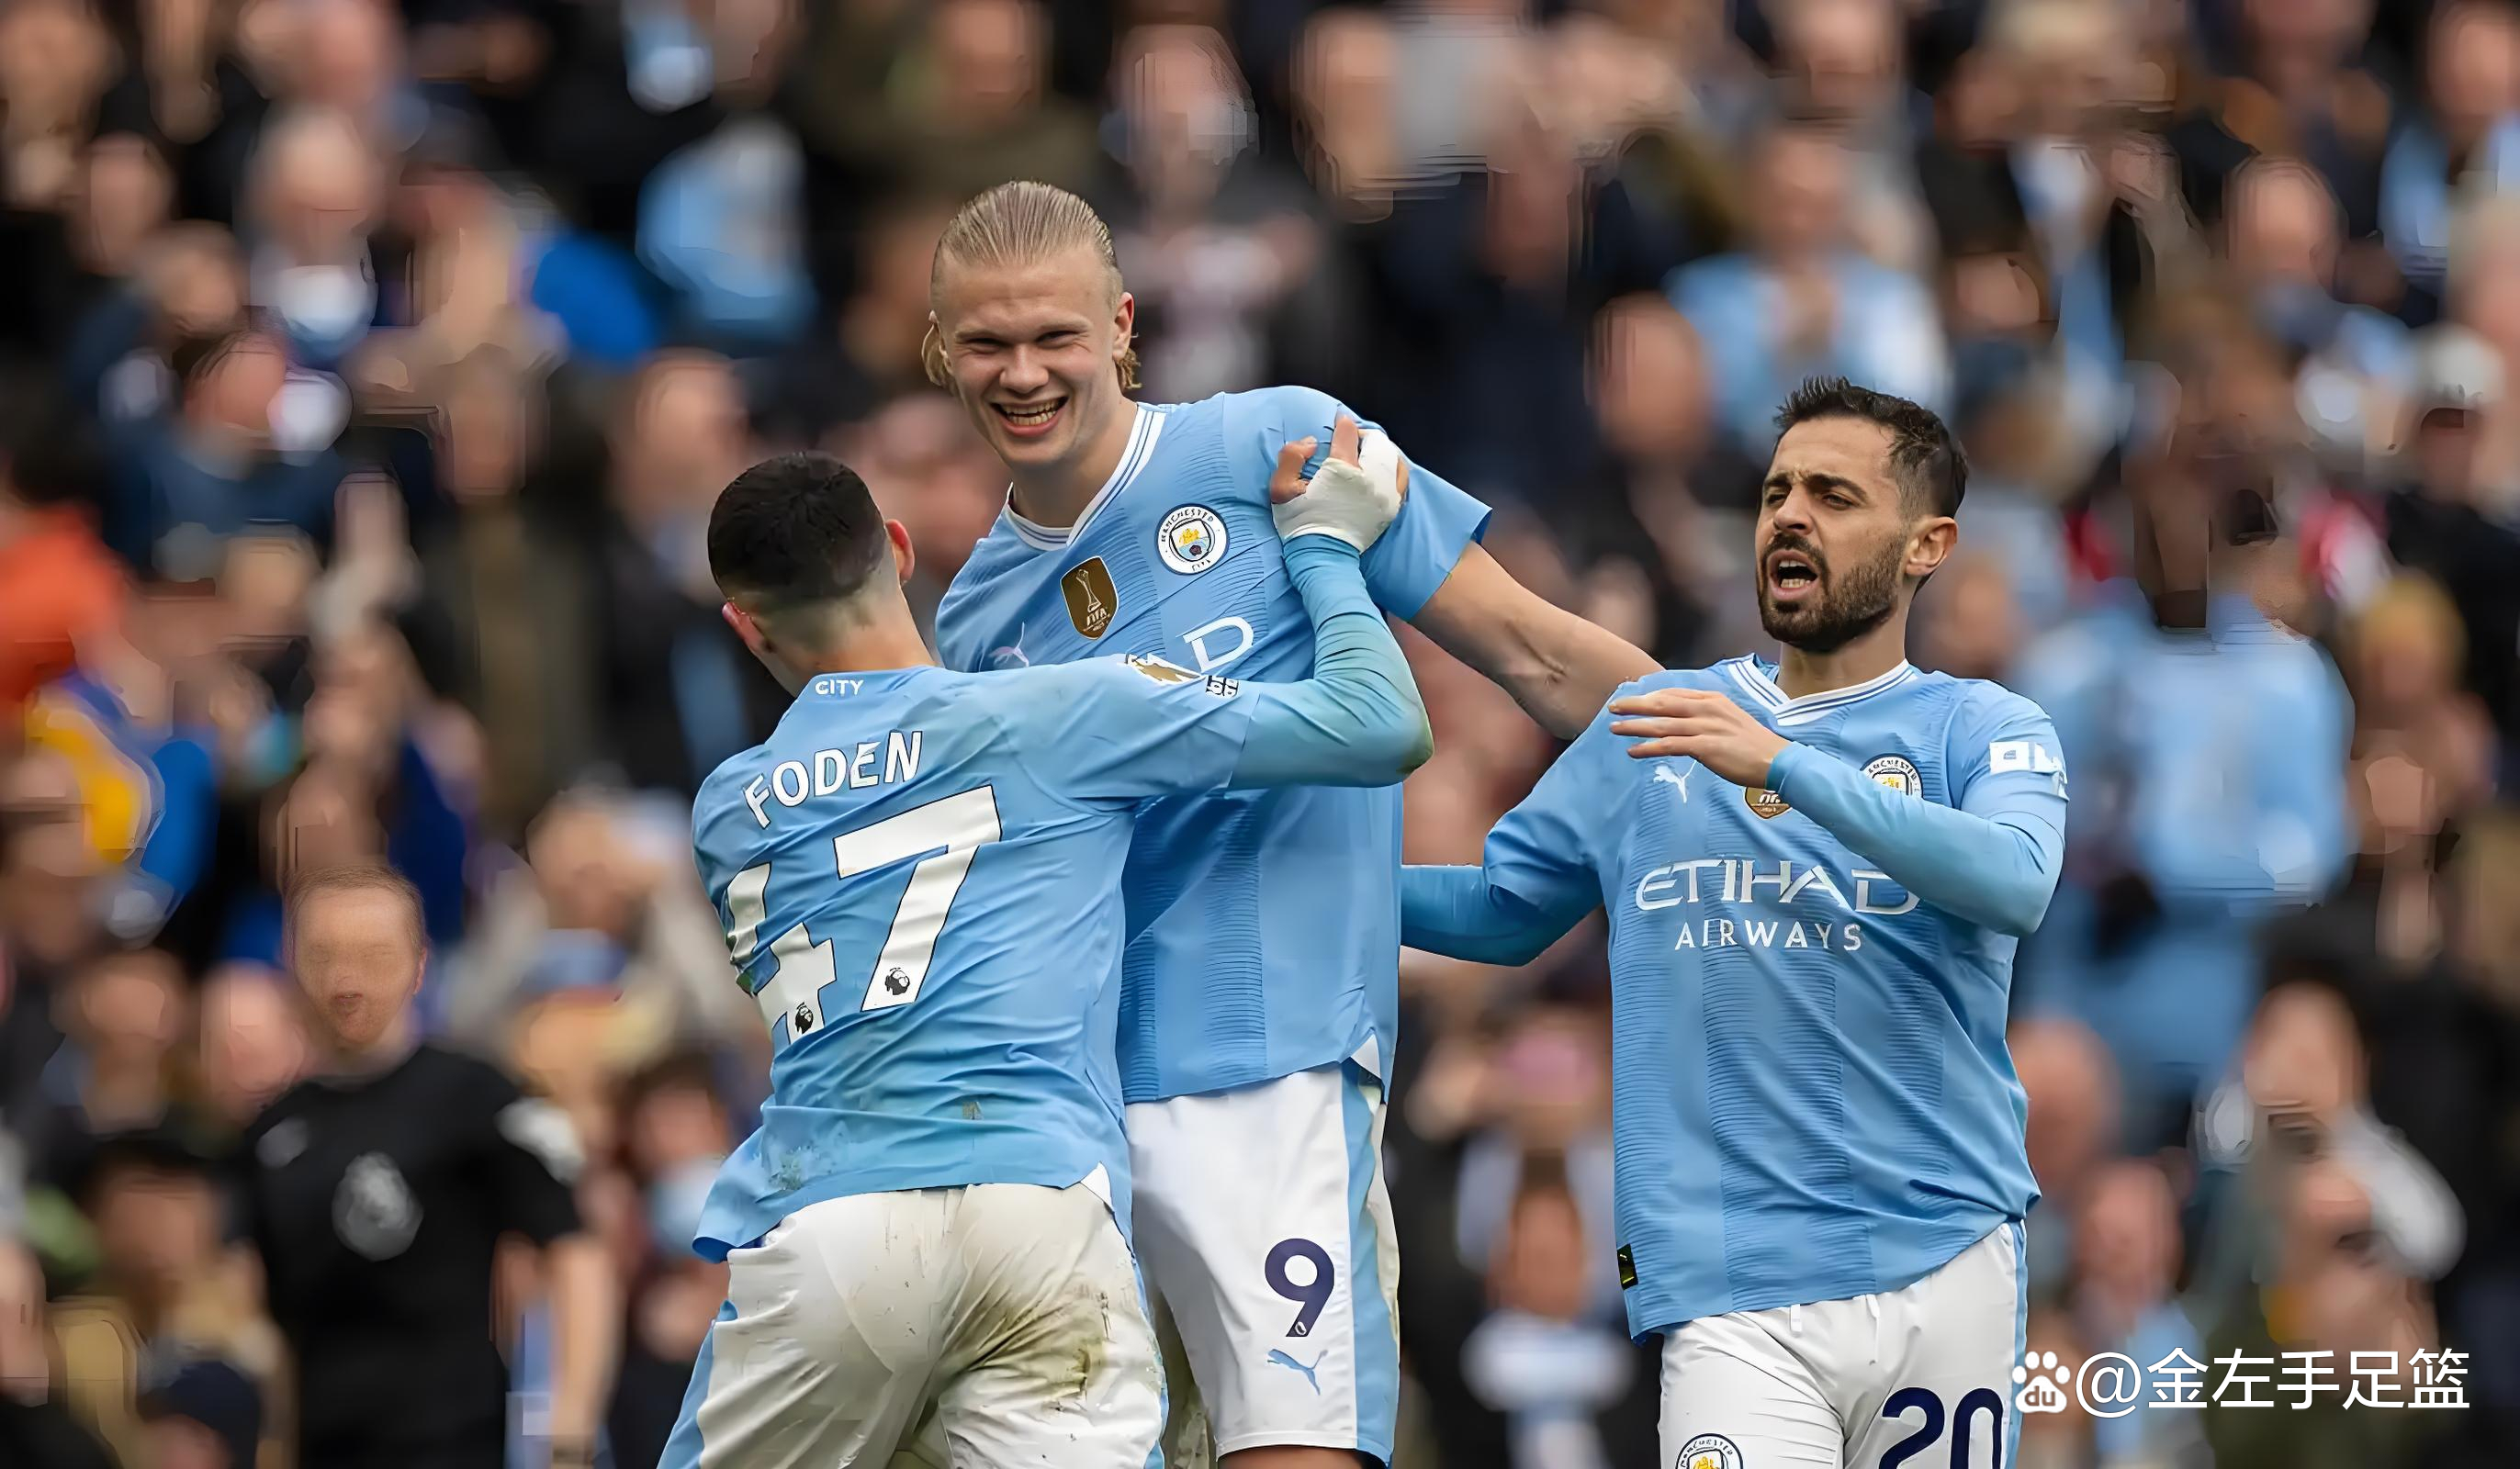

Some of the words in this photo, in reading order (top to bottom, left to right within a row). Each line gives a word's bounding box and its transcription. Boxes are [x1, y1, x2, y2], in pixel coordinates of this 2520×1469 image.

[815, 678, 865, 697] CITY
[741, 729, 924, 830] FODEN
[726, 784, 1004, 1046] 47
[1635, 858, 1922, 915] ETIHAD
[1674, 918, 1862, 952] AIRWAYS
[1264, 1238, 1335, 1338] 9
[1878, 1386, 2004, 1469] 20
